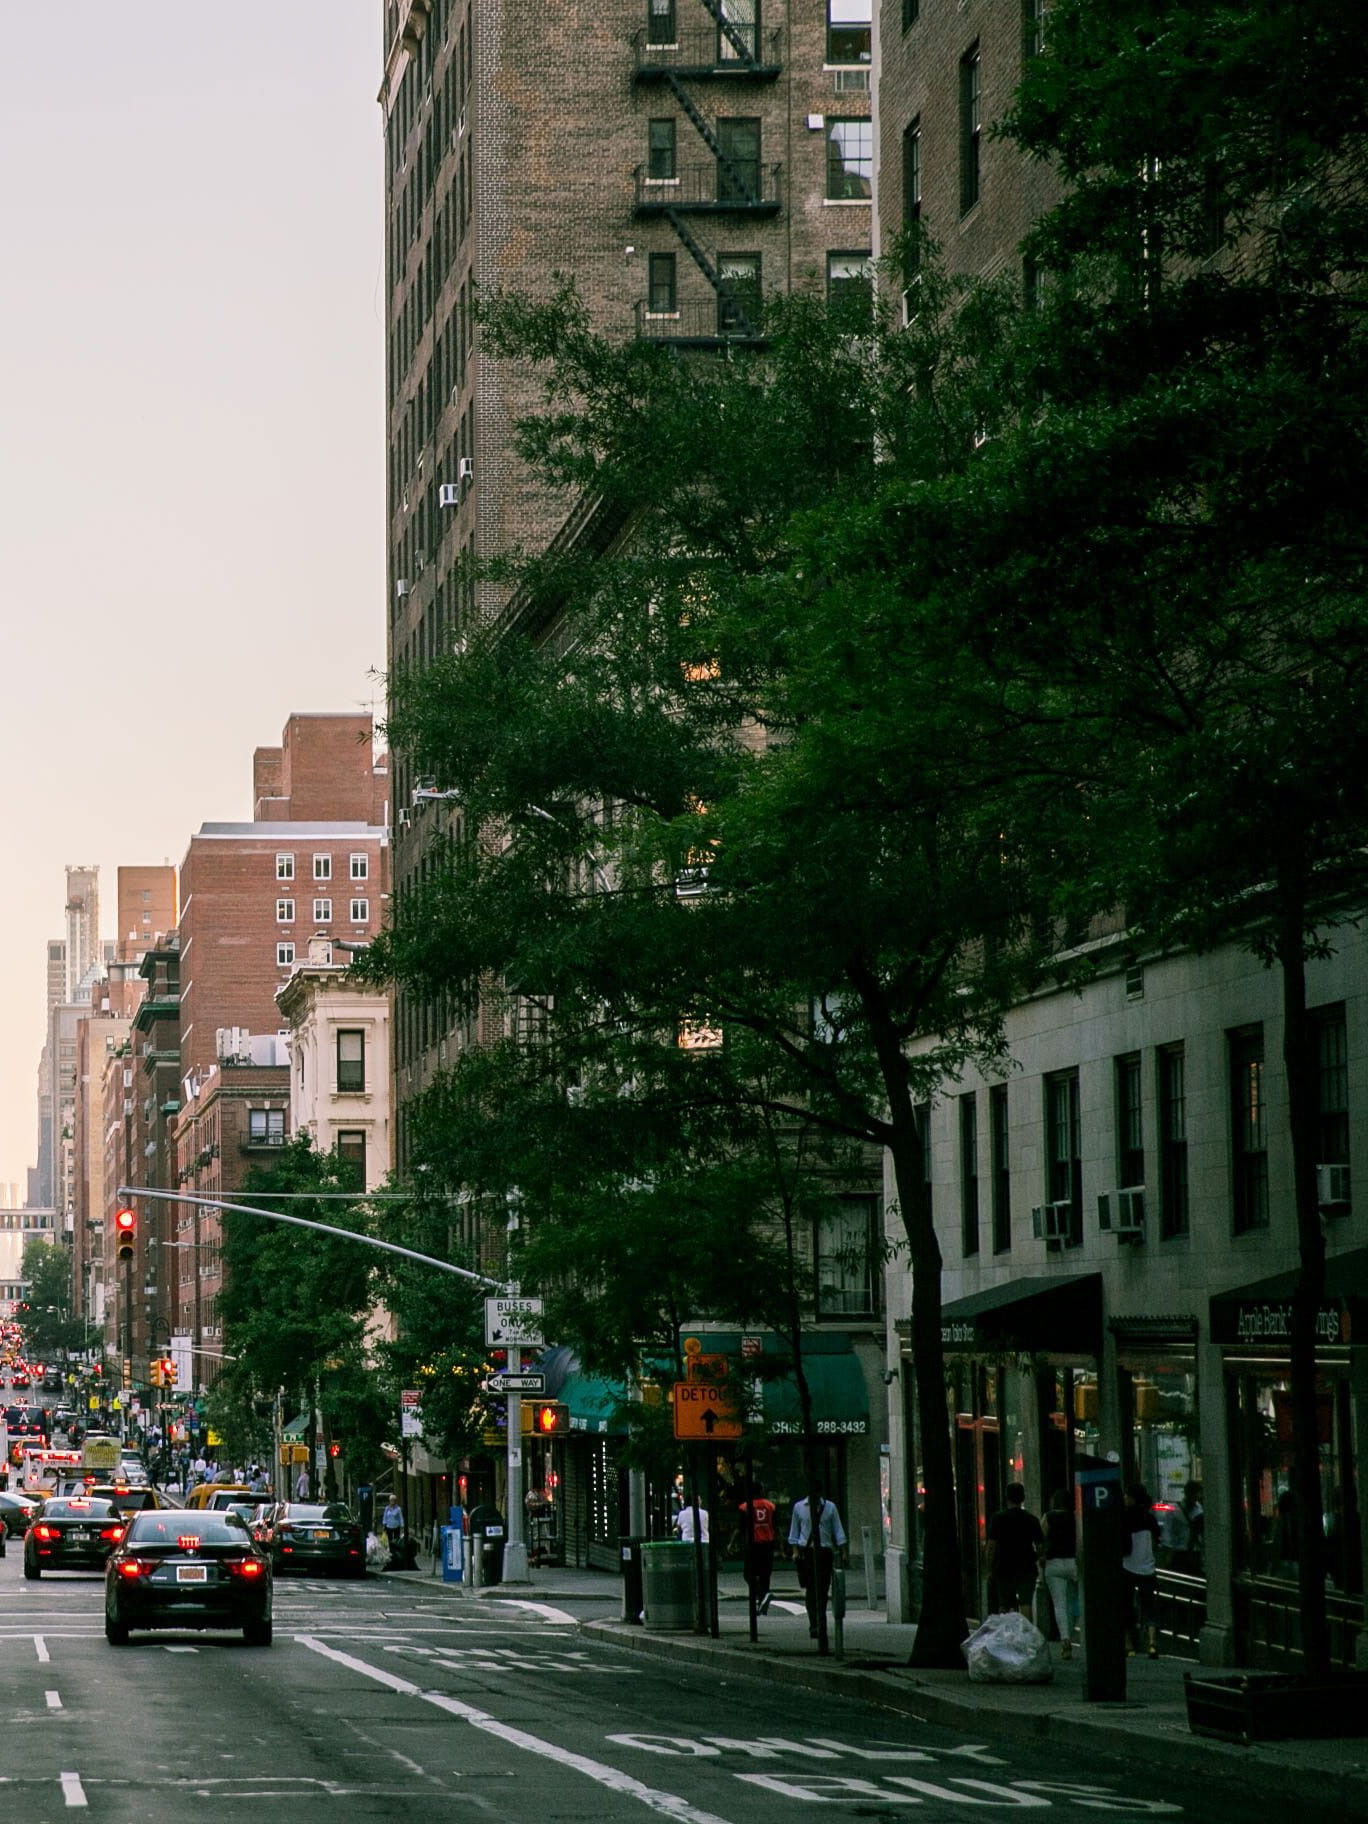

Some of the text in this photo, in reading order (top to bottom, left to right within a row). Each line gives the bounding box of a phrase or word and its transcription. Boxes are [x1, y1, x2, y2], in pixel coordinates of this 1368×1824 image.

[497, 1302, 532, 1312] BUSES
[493, 1379, 539, 1387] ONE WAY
[1094, 1486, 1109, 1508] P
[605, 1733, 1011, 1765] ONLY
[732, 1773, 1185, 1813] BUS
